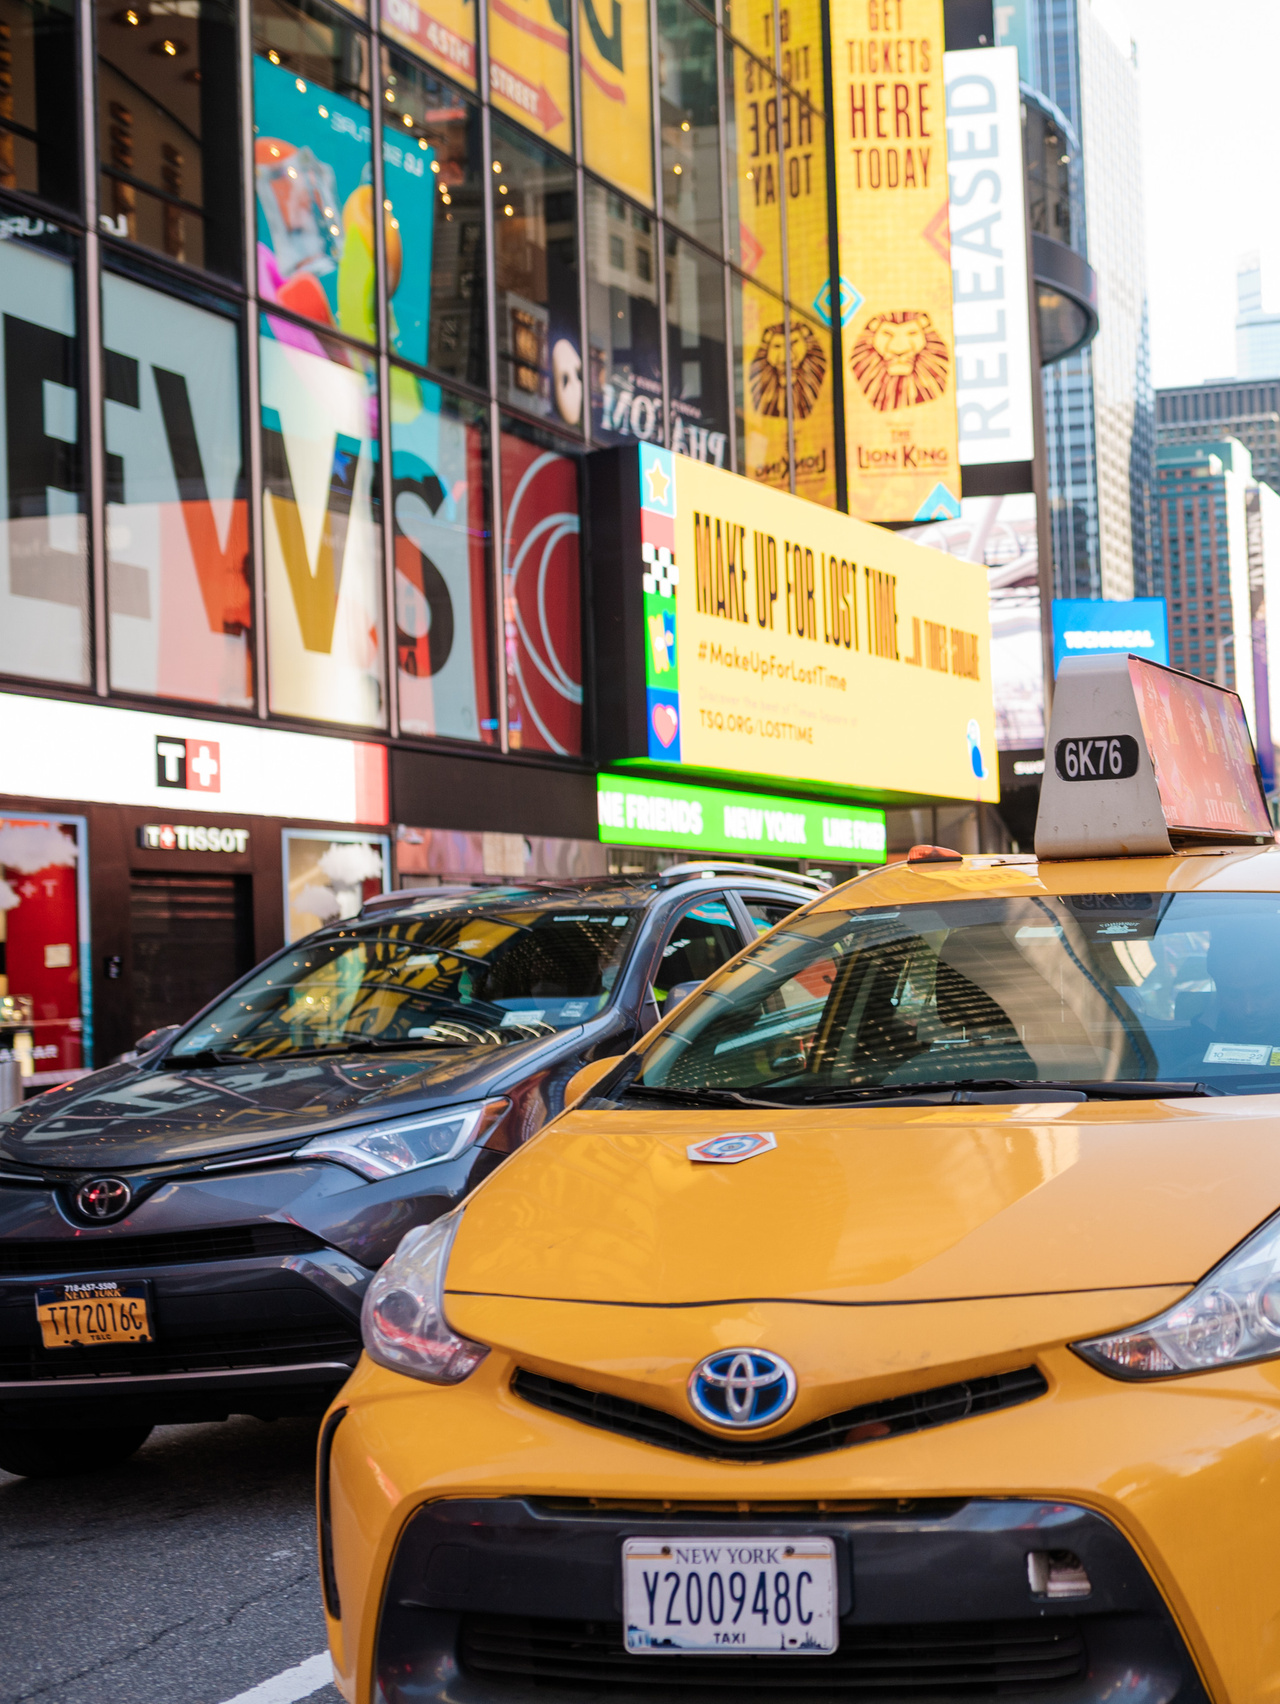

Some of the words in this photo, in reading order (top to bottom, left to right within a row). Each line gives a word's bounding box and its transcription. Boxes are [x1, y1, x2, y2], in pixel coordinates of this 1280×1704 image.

[868, 0, 904, 32] GET
[848, 39, 931, 73] TICKETS
[491, 62, 540, 114] STREET
[850, 83, 931, 139] HERE
[853, 148, 931, 189] TODAY
[945, 73, 1011, 442] RELEASED
[857, 446, 897, 469] LION
[902, 445, 949, 468] KING
[693, 510, 749, 624] MAKE
[754, 530, 778, 630] UP
[784, 540, 817, 641] FOR
[821, 552, 860, 651] LOST
[864, 566, 900, 661] TIME
[1065, 739, 1122, 777] 6K76
[626, 793, 703, 836] FRIENDS
[723, 805, 763, 841] NEW
[764, 810, 806, 844] YORK
[174, 825, 249, 853] TISSOT
[64, 1291, 91, 1300] NEW
[47, 1302, 142, 1335] T772016C
[675, 1547, 720, 1564] NEW
[728, 1547, 780, 1564] YORK
[643, 1571, 813, 1626] Y200948C
[714, 1633, 746, 1644] TAXI
